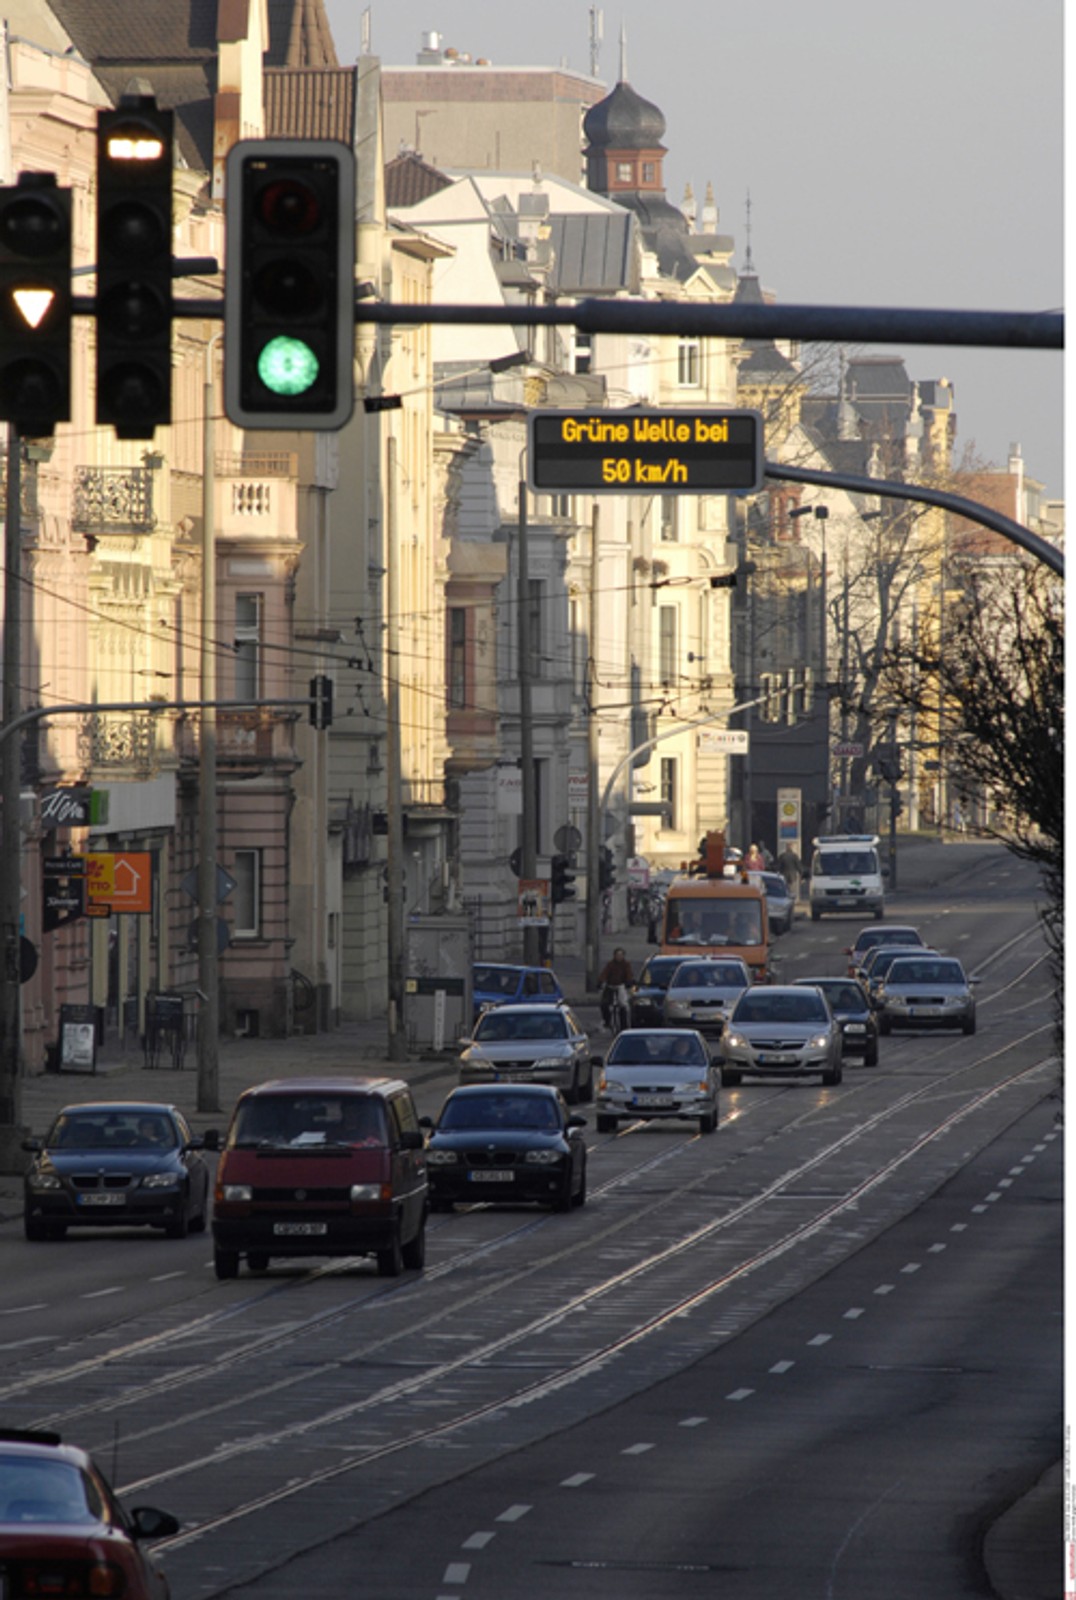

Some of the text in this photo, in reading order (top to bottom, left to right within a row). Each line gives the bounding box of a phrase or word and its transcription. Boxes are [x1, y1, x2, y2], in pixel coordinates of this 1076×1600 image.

[561, 417, 728, 442] Grüne Welle bei
[602, 458, 688, 483] 50 km/h
